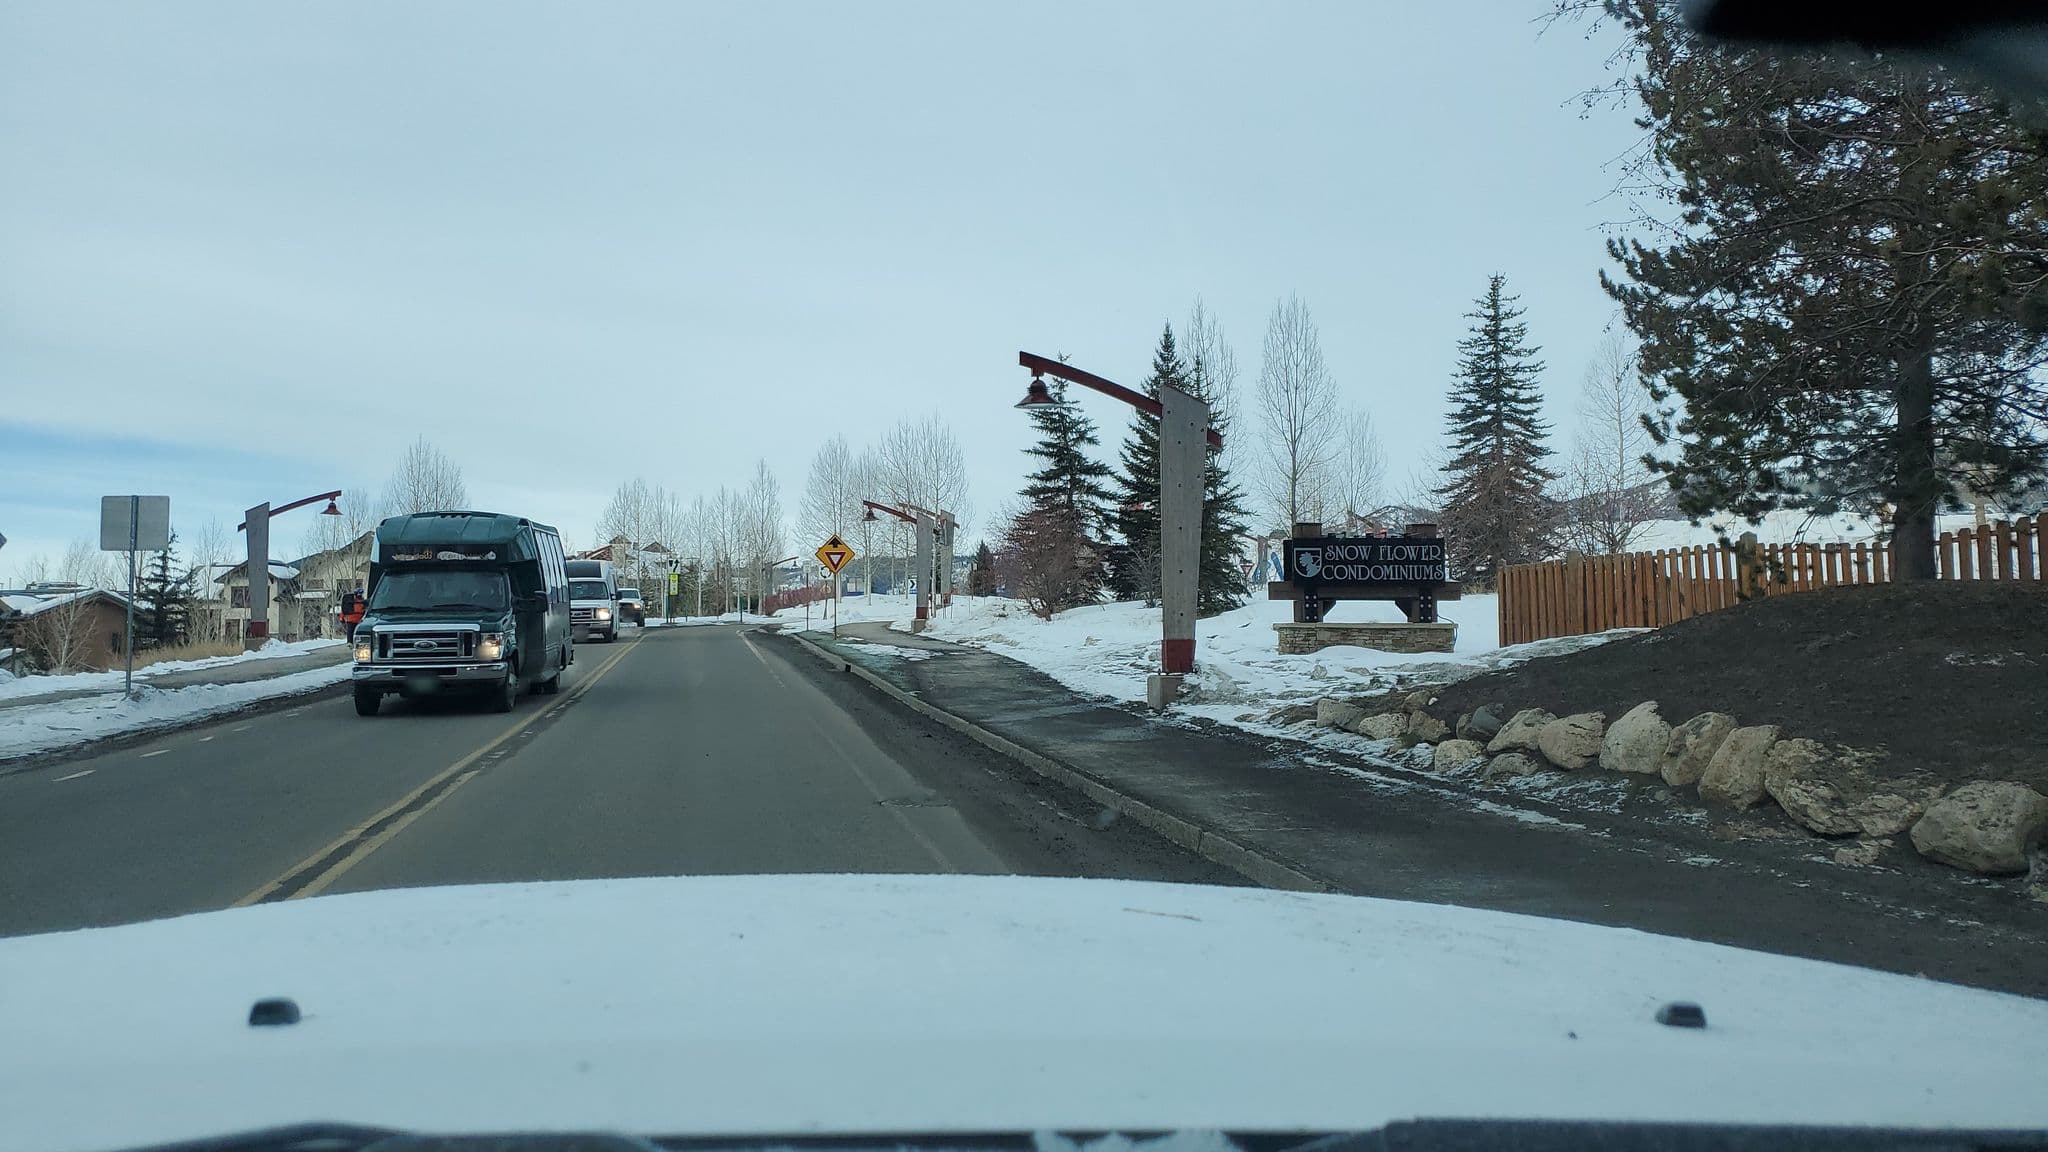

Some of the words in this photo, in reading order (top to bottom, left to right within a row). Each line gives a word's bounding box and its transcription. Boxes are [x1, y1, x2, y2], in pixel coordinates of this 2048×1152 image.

[1324, 545, 1372, 561] SNOW
[1379, 545, 1441, 561] FLOWER
[1322, 564, 1444, 580] CONDOMINIUMS
